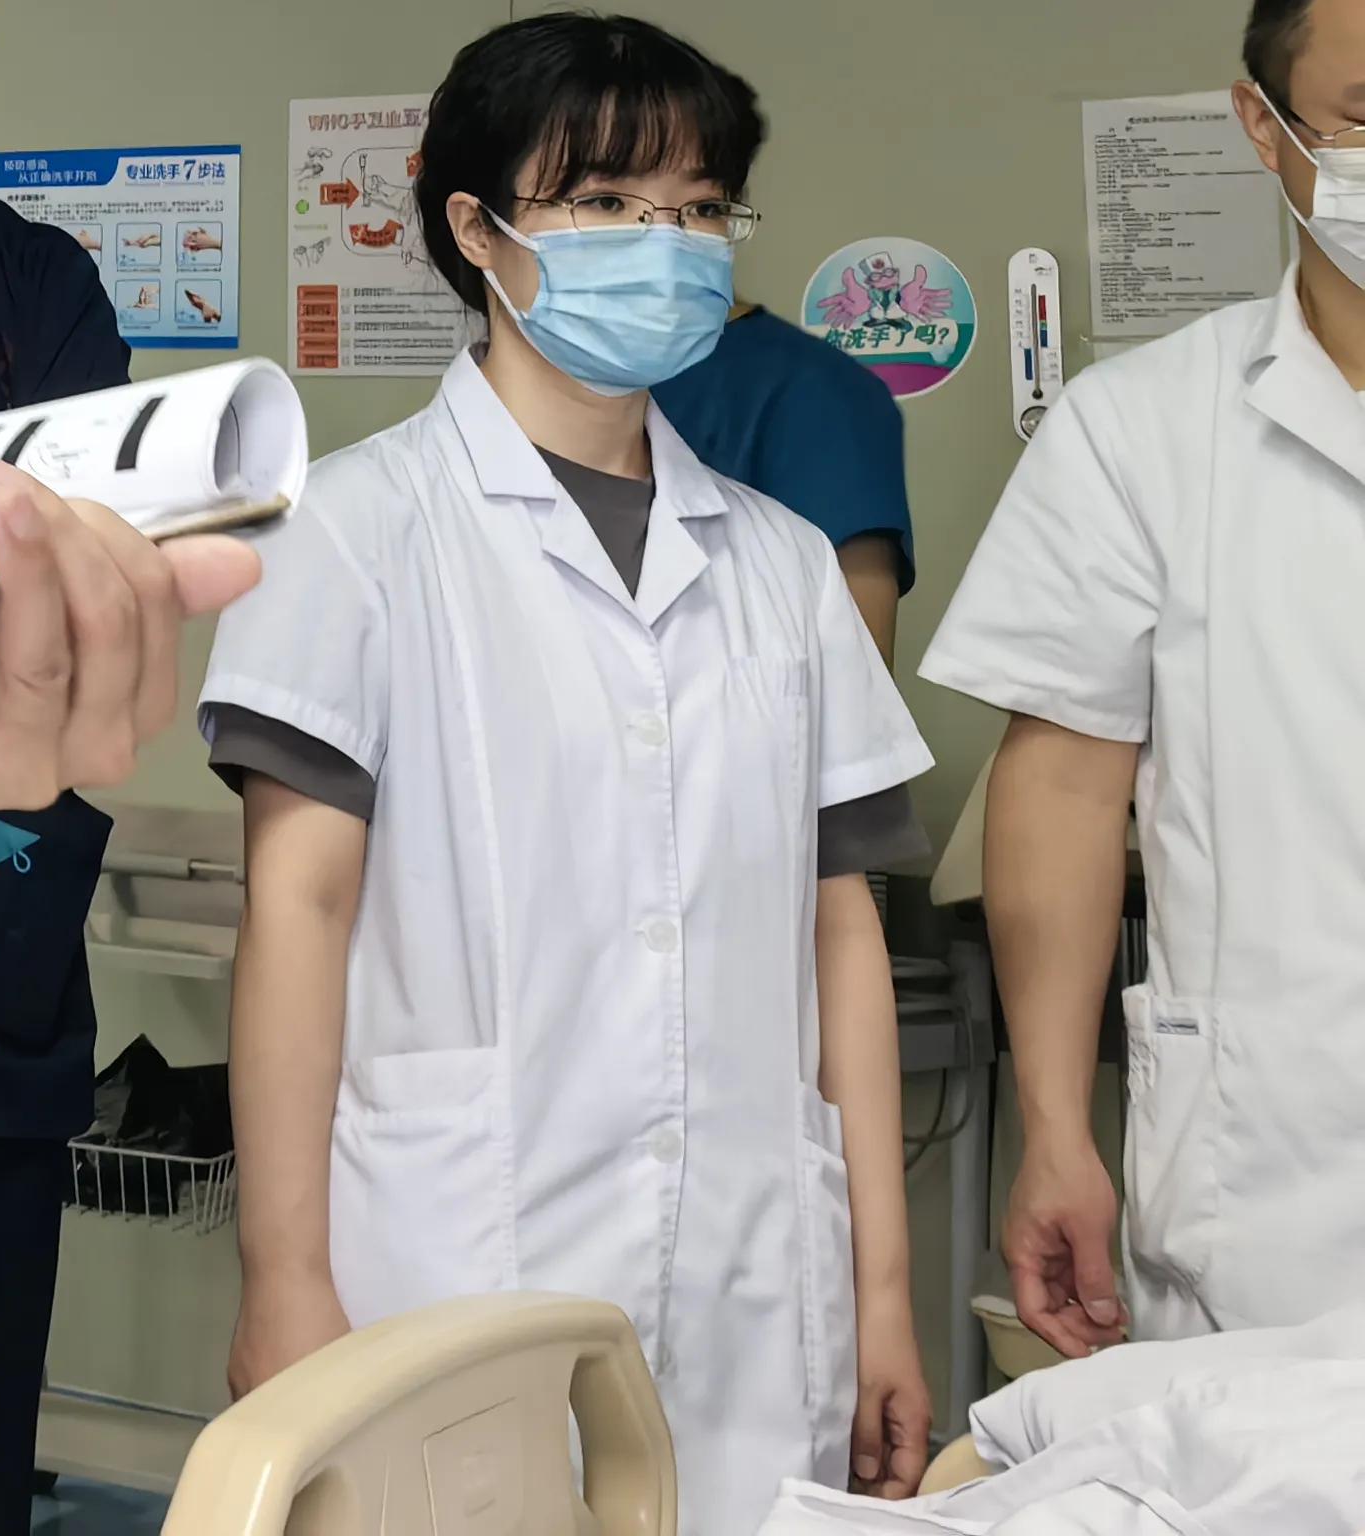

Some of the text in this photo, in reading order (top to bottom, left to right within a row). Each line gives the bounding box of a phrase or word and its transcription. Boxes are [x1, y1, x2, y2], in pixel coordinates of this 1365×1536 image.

[125, 158, 226, 181] 专业洗手7步法
